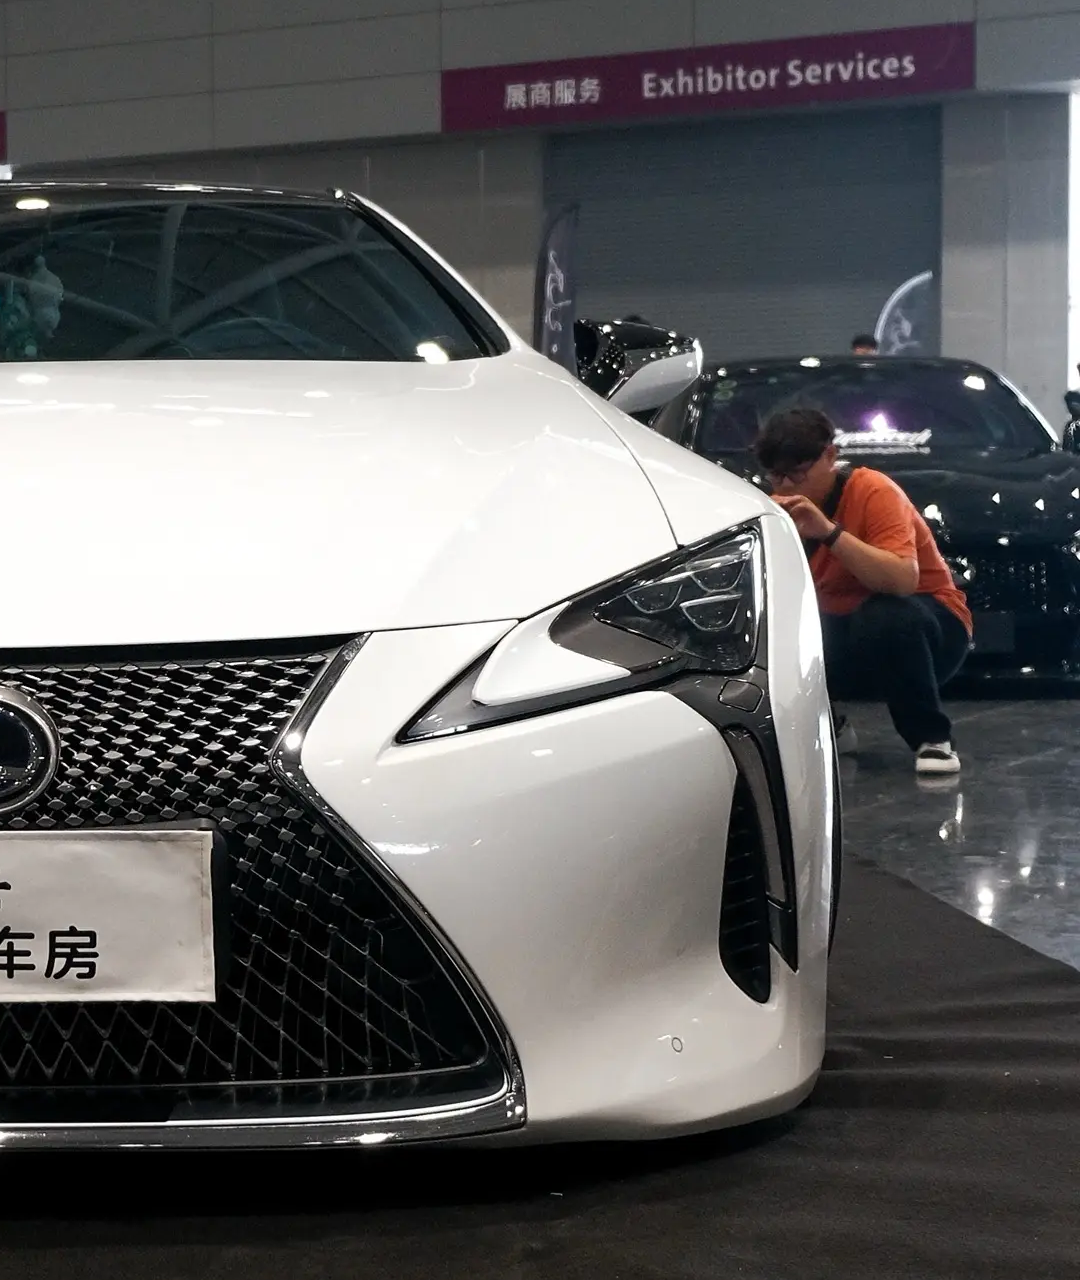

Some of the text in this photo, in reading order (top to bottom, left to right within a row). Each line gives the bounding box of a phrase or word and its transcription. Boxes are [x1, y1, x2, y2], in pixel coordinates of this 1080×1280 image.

[504, 76, 602, 111] 展商服务
[641, 51, 916, 99] Exhibitor Services
